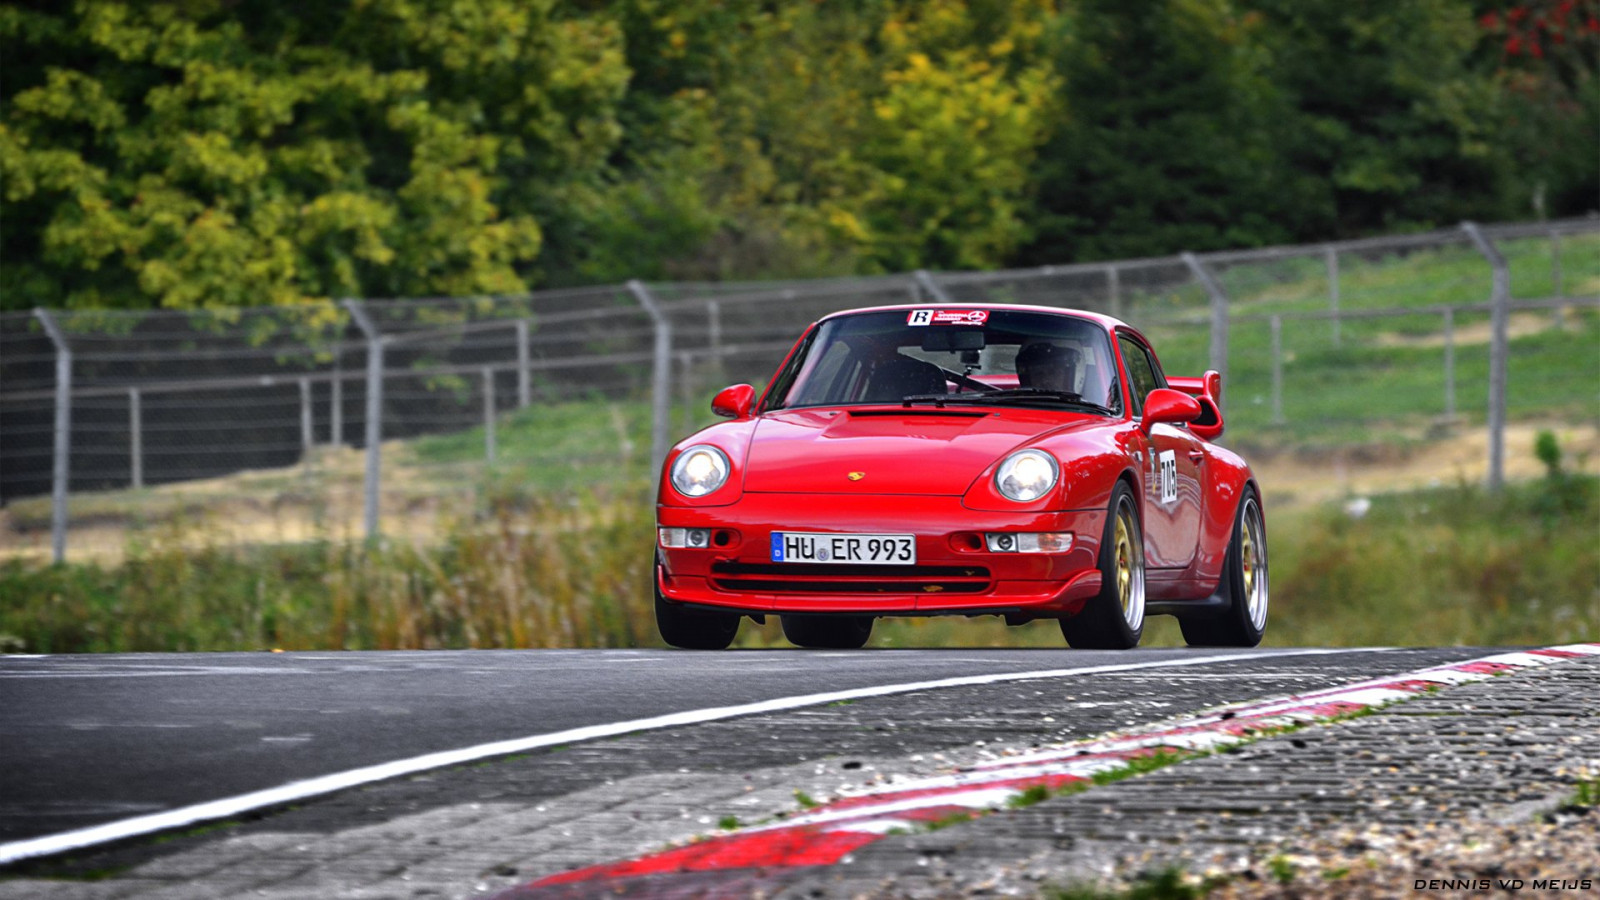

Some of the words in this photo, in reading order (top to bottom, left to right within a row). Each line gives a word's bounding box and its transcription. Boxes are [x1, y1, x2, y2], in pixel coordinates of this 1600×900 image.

[913, 311, 928, 322] R
[1161, 460, 1175, 498] 705
[785, 537, 815, 559] HU
[831, 538, 861, 560] ER
[868, 539, 912, 560] 993
